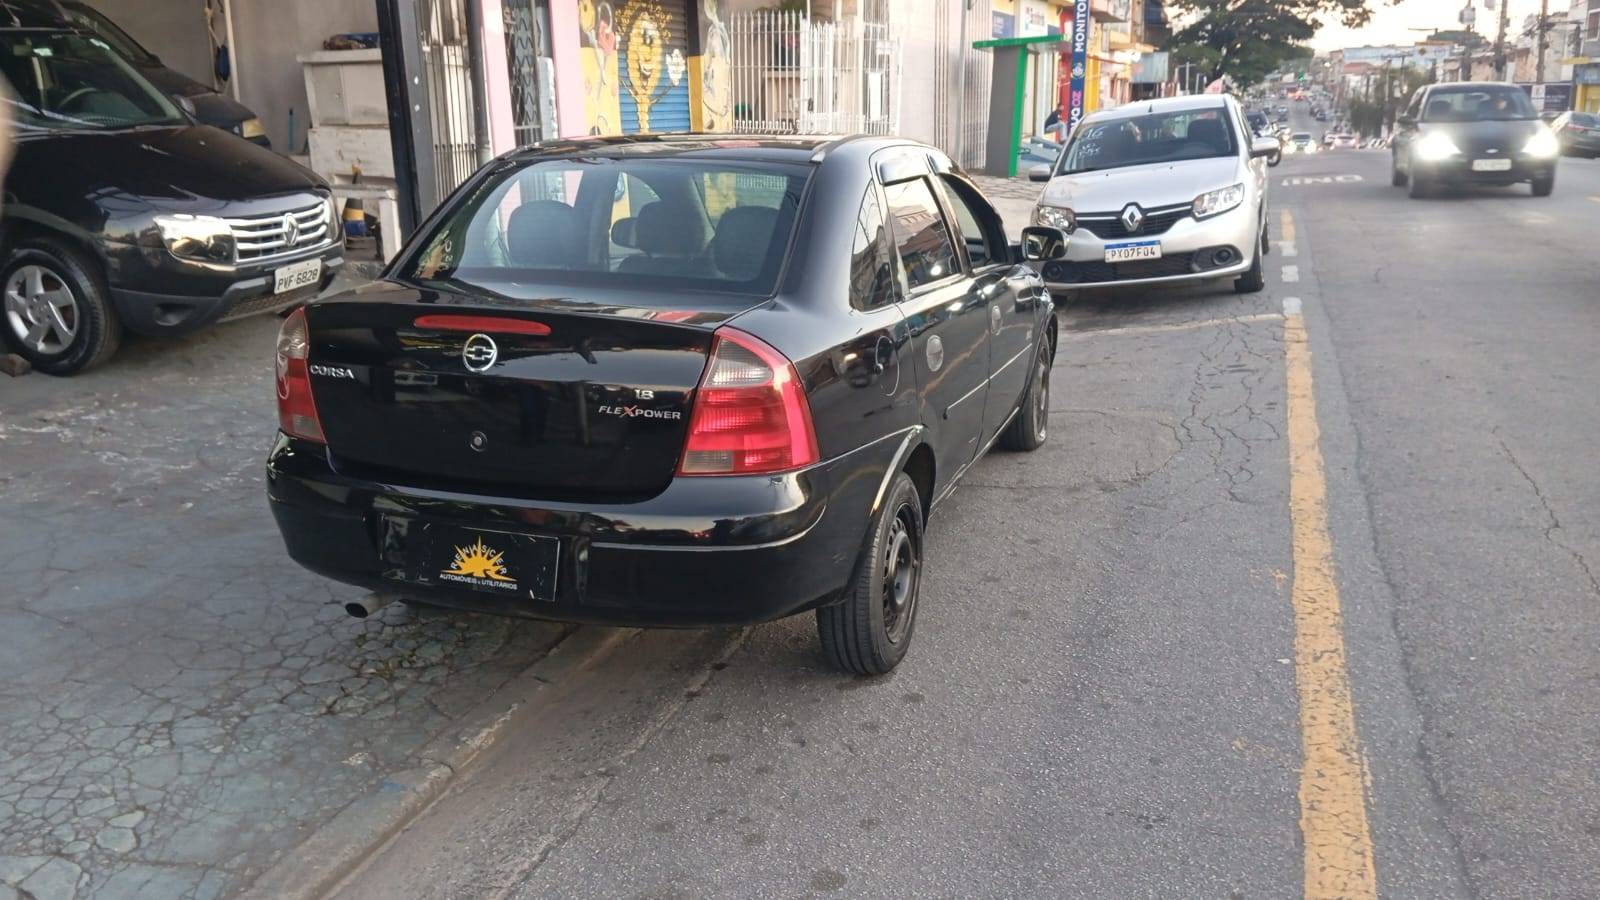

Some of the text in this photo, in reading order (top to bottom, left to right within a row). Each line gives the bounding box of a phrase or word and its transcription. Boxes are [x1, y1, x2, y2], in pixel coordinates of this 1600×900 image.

[1075, 0, 1087, 52] MONITO
[296, 268, 319, 285] 6828
[310, 365, 354, 379] CORSA
[450, 544, 507, 574] RENASCER
